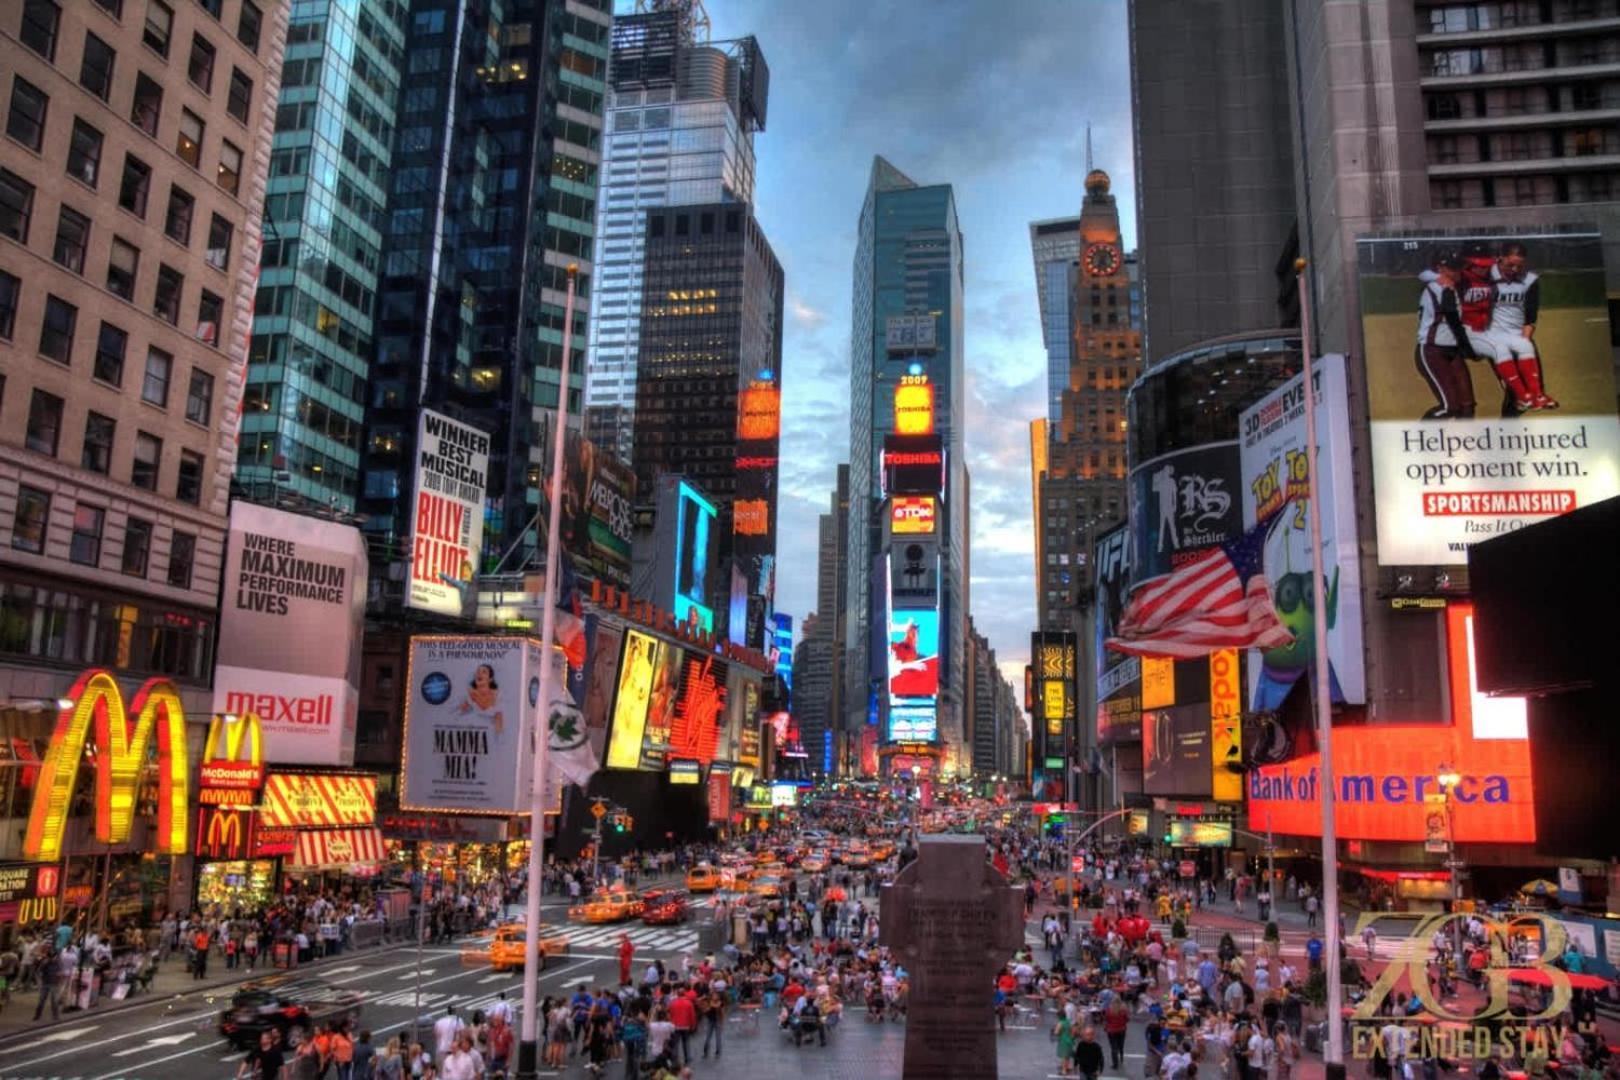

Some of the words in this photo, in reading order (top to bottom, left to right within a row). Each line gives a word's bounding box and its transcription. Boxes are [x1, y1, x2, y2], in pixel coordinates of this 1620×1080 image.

[1245, 413, 1260, 436] 3D
[1282, 370, 1321, 414] EVET
[425, 414, 488, 456] WINNER
[1402, 427, 1492, 458] Helped
[1499, 425, 1588, 456] injured
[438, 439, 473, 466] BEST
[885, 453, 941, 465] TOSHIBA
[421, 451, 485, 488] MUSICAL
[1252, 456, 1280, 505] TOY
[1406, 459, 1527, 486] opponent
[1532, 453, 1588, 478] win.
[416, 491, 464, 544] BILLY
[1427, 493, 1572, 513] SPORTSMANSHIP
[1465, 519, 1492, 533] Pass
[1496, 520, 1506, 533] It
[244, 532, 296, 557] WHERE
[240, 548, 346, 588] MAXIMUM
[413, 536, 469, 588] ELLIOT
[236, 589, 289, 616] LIVES
[239, 572, 344, 605] PERFORMANCE
[226, 690, 333, 725] maxell
[434, 729, 489, 755] MAMMA
[202, 767, 259, 779] McDonald's
[443, 754, 477, 779] MIA!
[1251, 768, 1293, 801] Bank
[1297, 767, 1318, 801] of
[1331, 771, 1510, 803] merca
